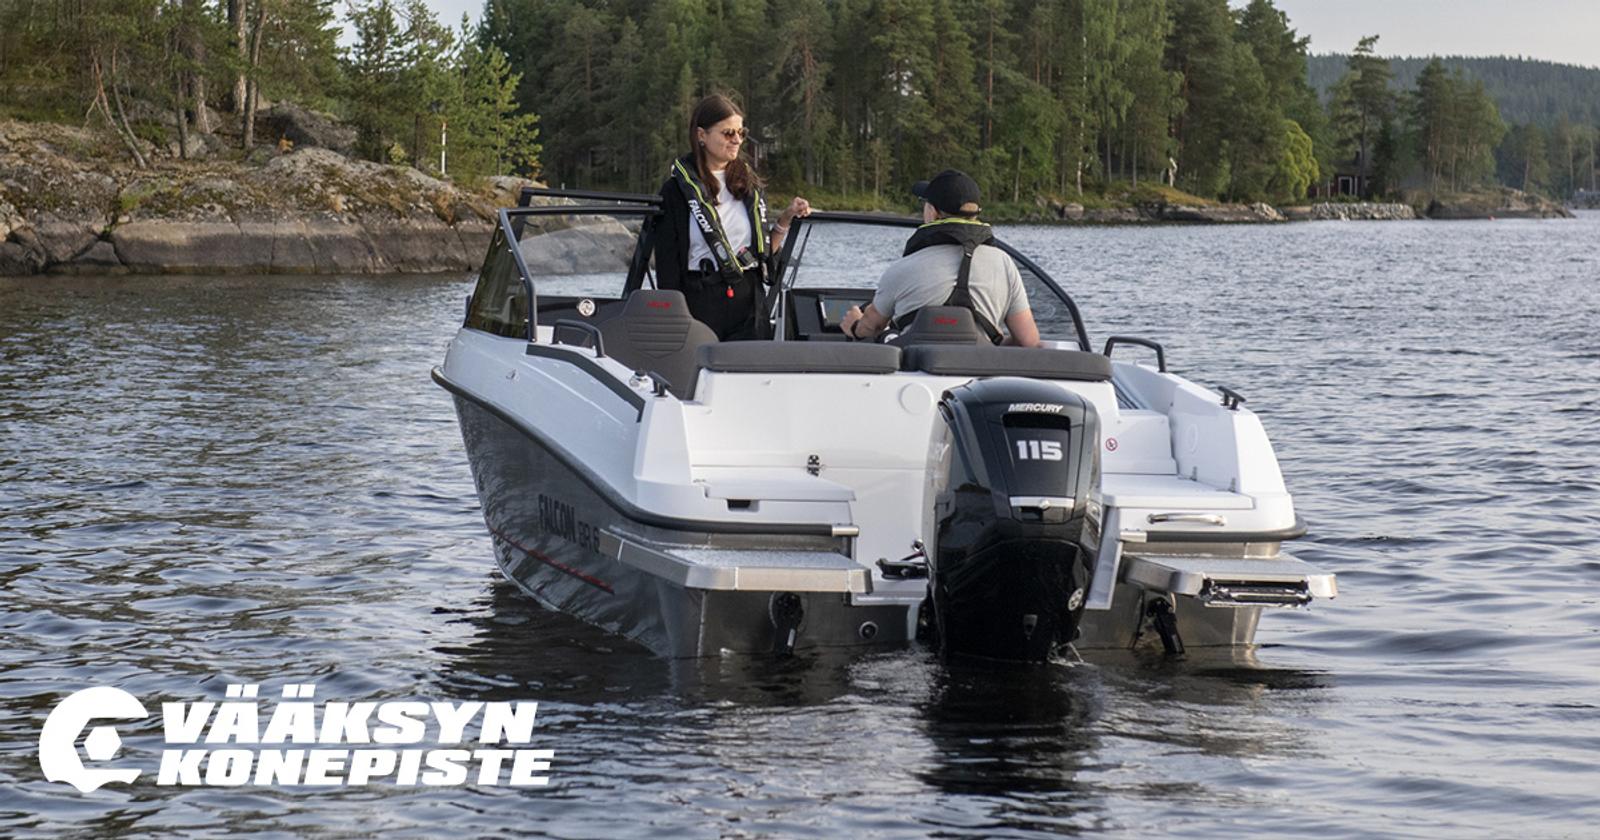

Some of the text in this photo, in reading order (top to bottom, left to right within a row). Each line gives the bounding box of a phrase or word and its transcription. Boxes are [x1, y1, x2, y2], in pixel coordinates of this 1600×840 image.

[688, 199, 713, 232] FALCON
[1008, 402, 1064, 413] MERCURY
[1016, 440, 1063, 461] 115
[538, 494, 576, 543] FALCON
